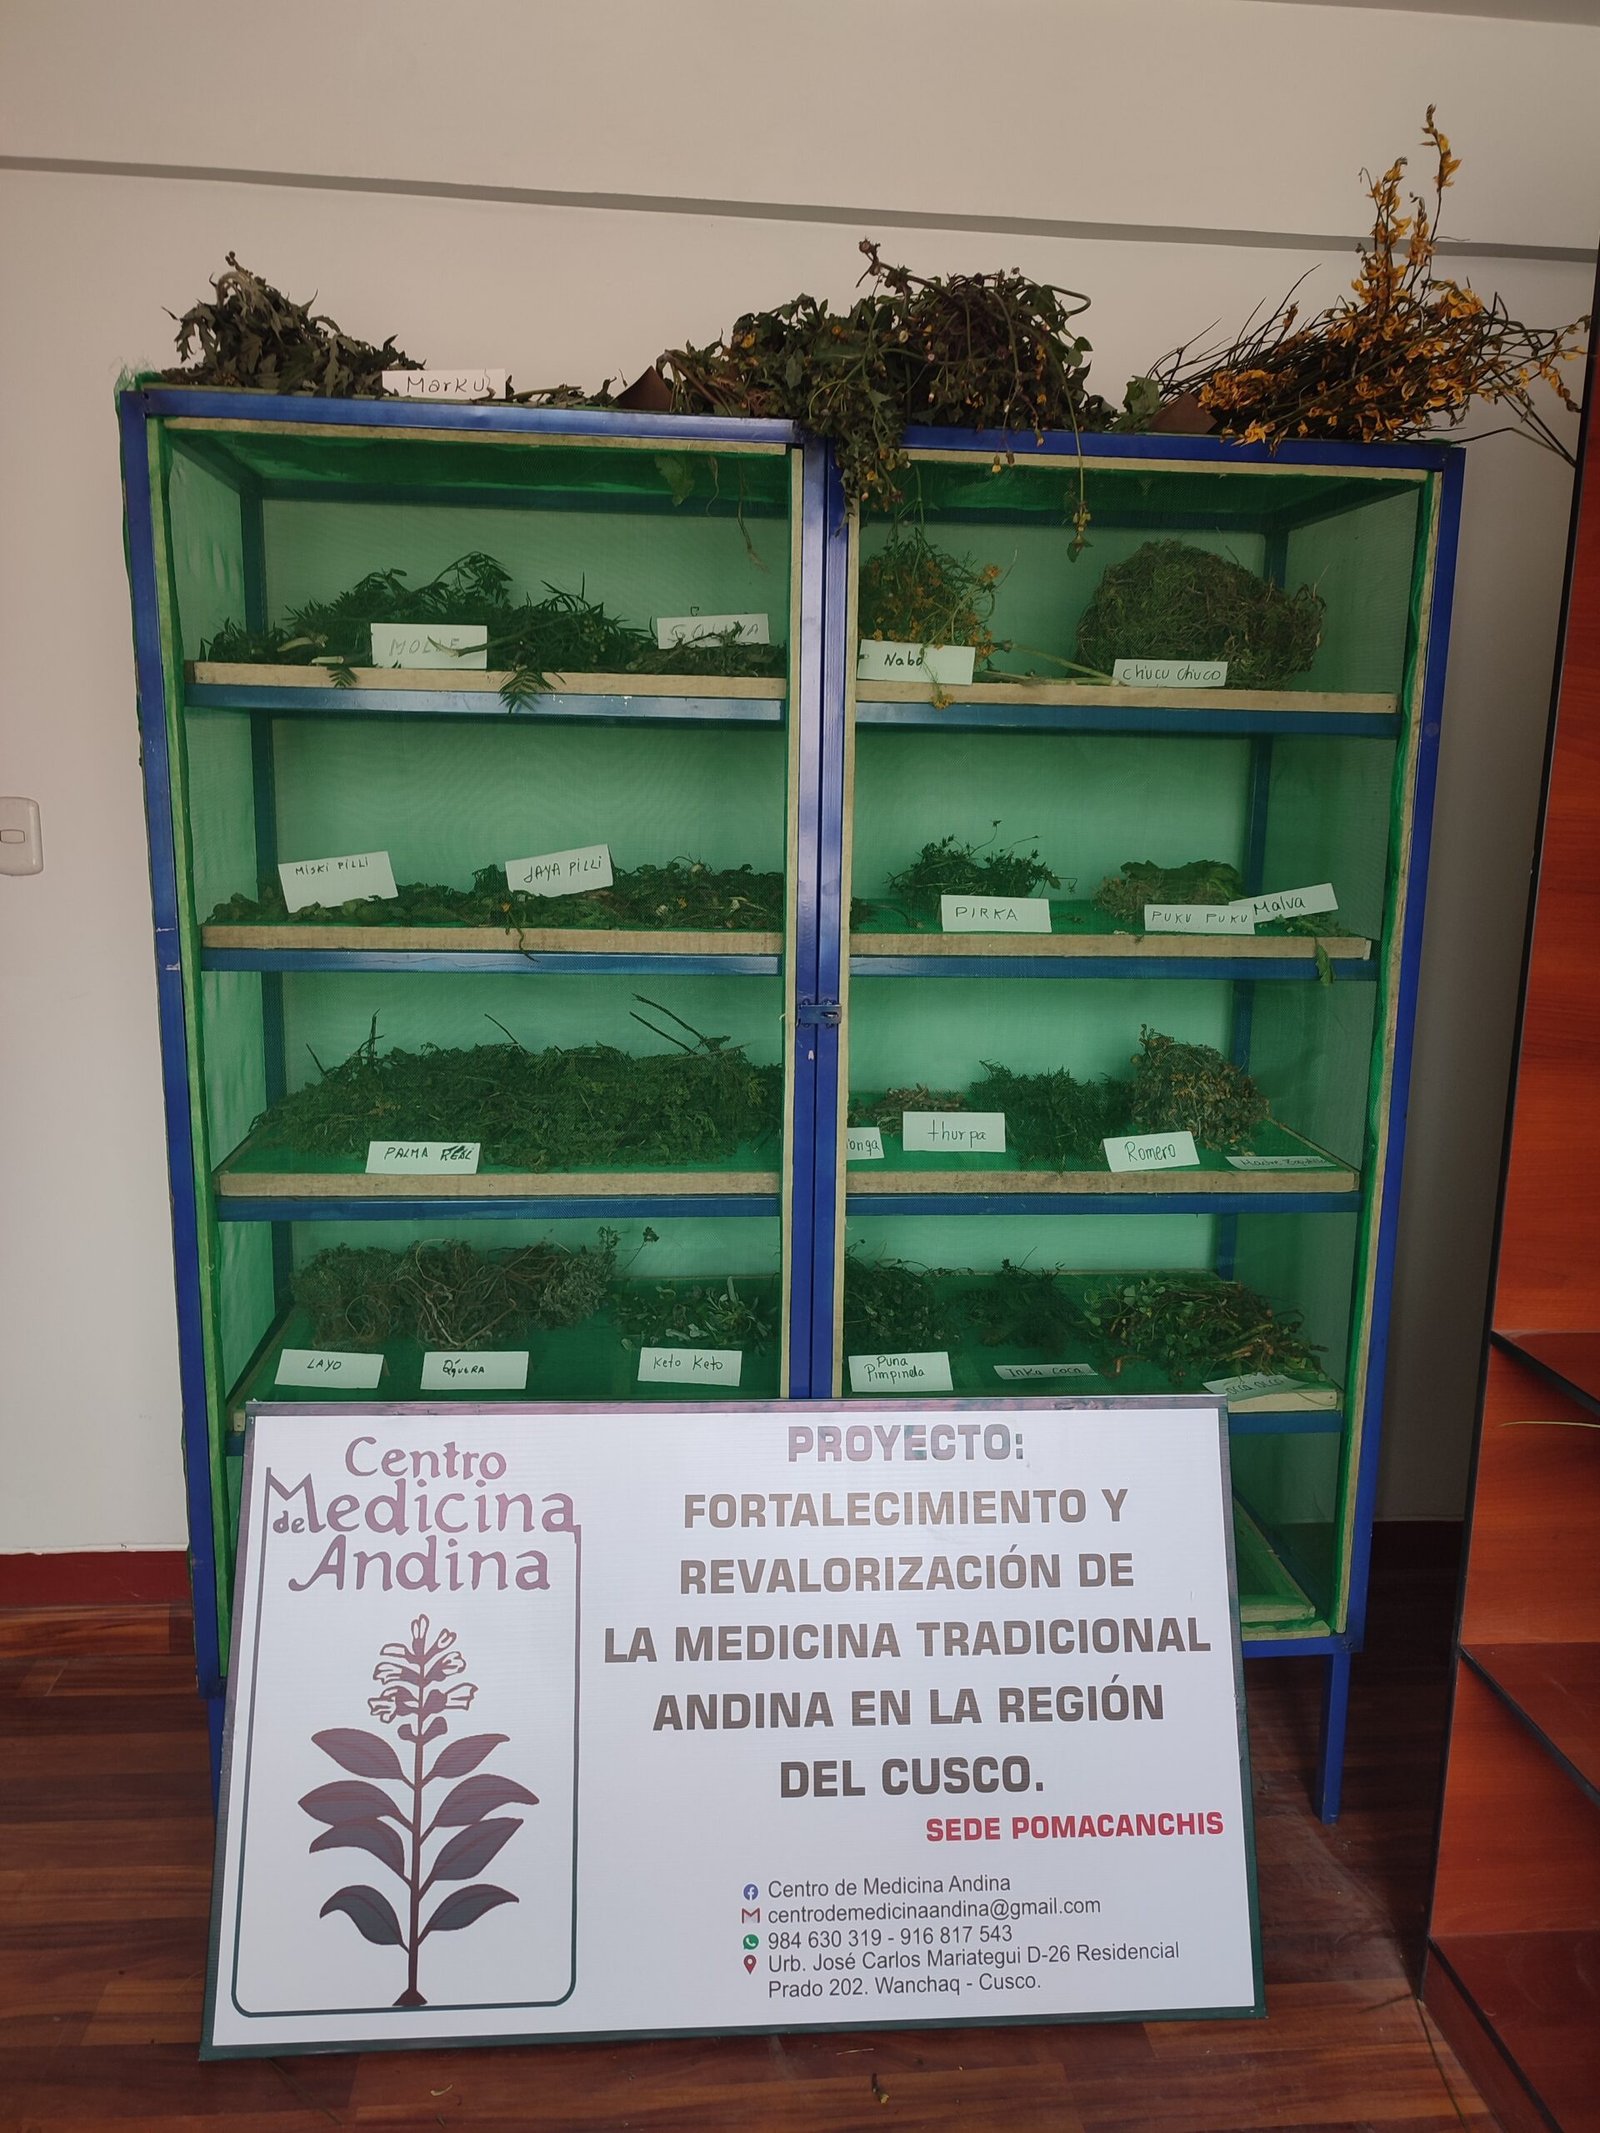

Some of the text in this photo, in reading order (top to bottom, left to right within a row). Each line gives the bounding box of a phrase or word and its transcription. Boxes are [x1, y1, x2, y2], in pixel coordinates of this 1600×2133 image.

[956, 906, 1018, 921] PIRKA
[1254, 895, 1306, 915] Malva
[384, 1147, 428, 1160] PALMA
[1124, 1141, 1176, 1162] Romero
[307, 1358, 342, 1372] LAYO
[877, 1355, 908, 1368] Puna
[345, 1436, 507, 1480] Centro
[788, 1423, 1023, 1463] PROYECTO:
[263, 1467, 576, 1536] de Medicina
[684, 1488, 1129, 1528] FORTALECIMIENTO Y
[288, 1534, 551, 1592] Andina
[680, 1544, 1134, 1595] REVALORIZACIÓN DE
[604, 1617, 1211, 1663] LA MEDICINA TRADICIONAL
[653, 1674, 1164, 1731] ANDINA EN LA REGIÓN
[780, 1755, 1044, 1799] DEL CUSCO.
[926, 1811, 1224, 1842] SEDE POMACANCHIS
[768, 1875, 1011, 1898] Centro de Medicina Andina
[768, 1897, 1101, 1924] centrodemedicinaandina@gmail.com
[768, 1931, 801, 1949] 984
[808, 1930, 842, 1948] 630
[848, 1928, 882, 1947] 319
[900, 1927, 934, 1945] 916
[940, 1926, 973, 1944] 817
[979, 1924, 1013, 1942] 543
[769, 1941, 1179, 1973] Urb. José Carlos Mariategui D-26 Residencial
[769, 1979, 823, 1998] Prado
[829, 1977, 868, 1996] 202.
[875, 1975, 960, 1996] Wanchaq
[979, 1972, 1041, 1991] Cusco.
